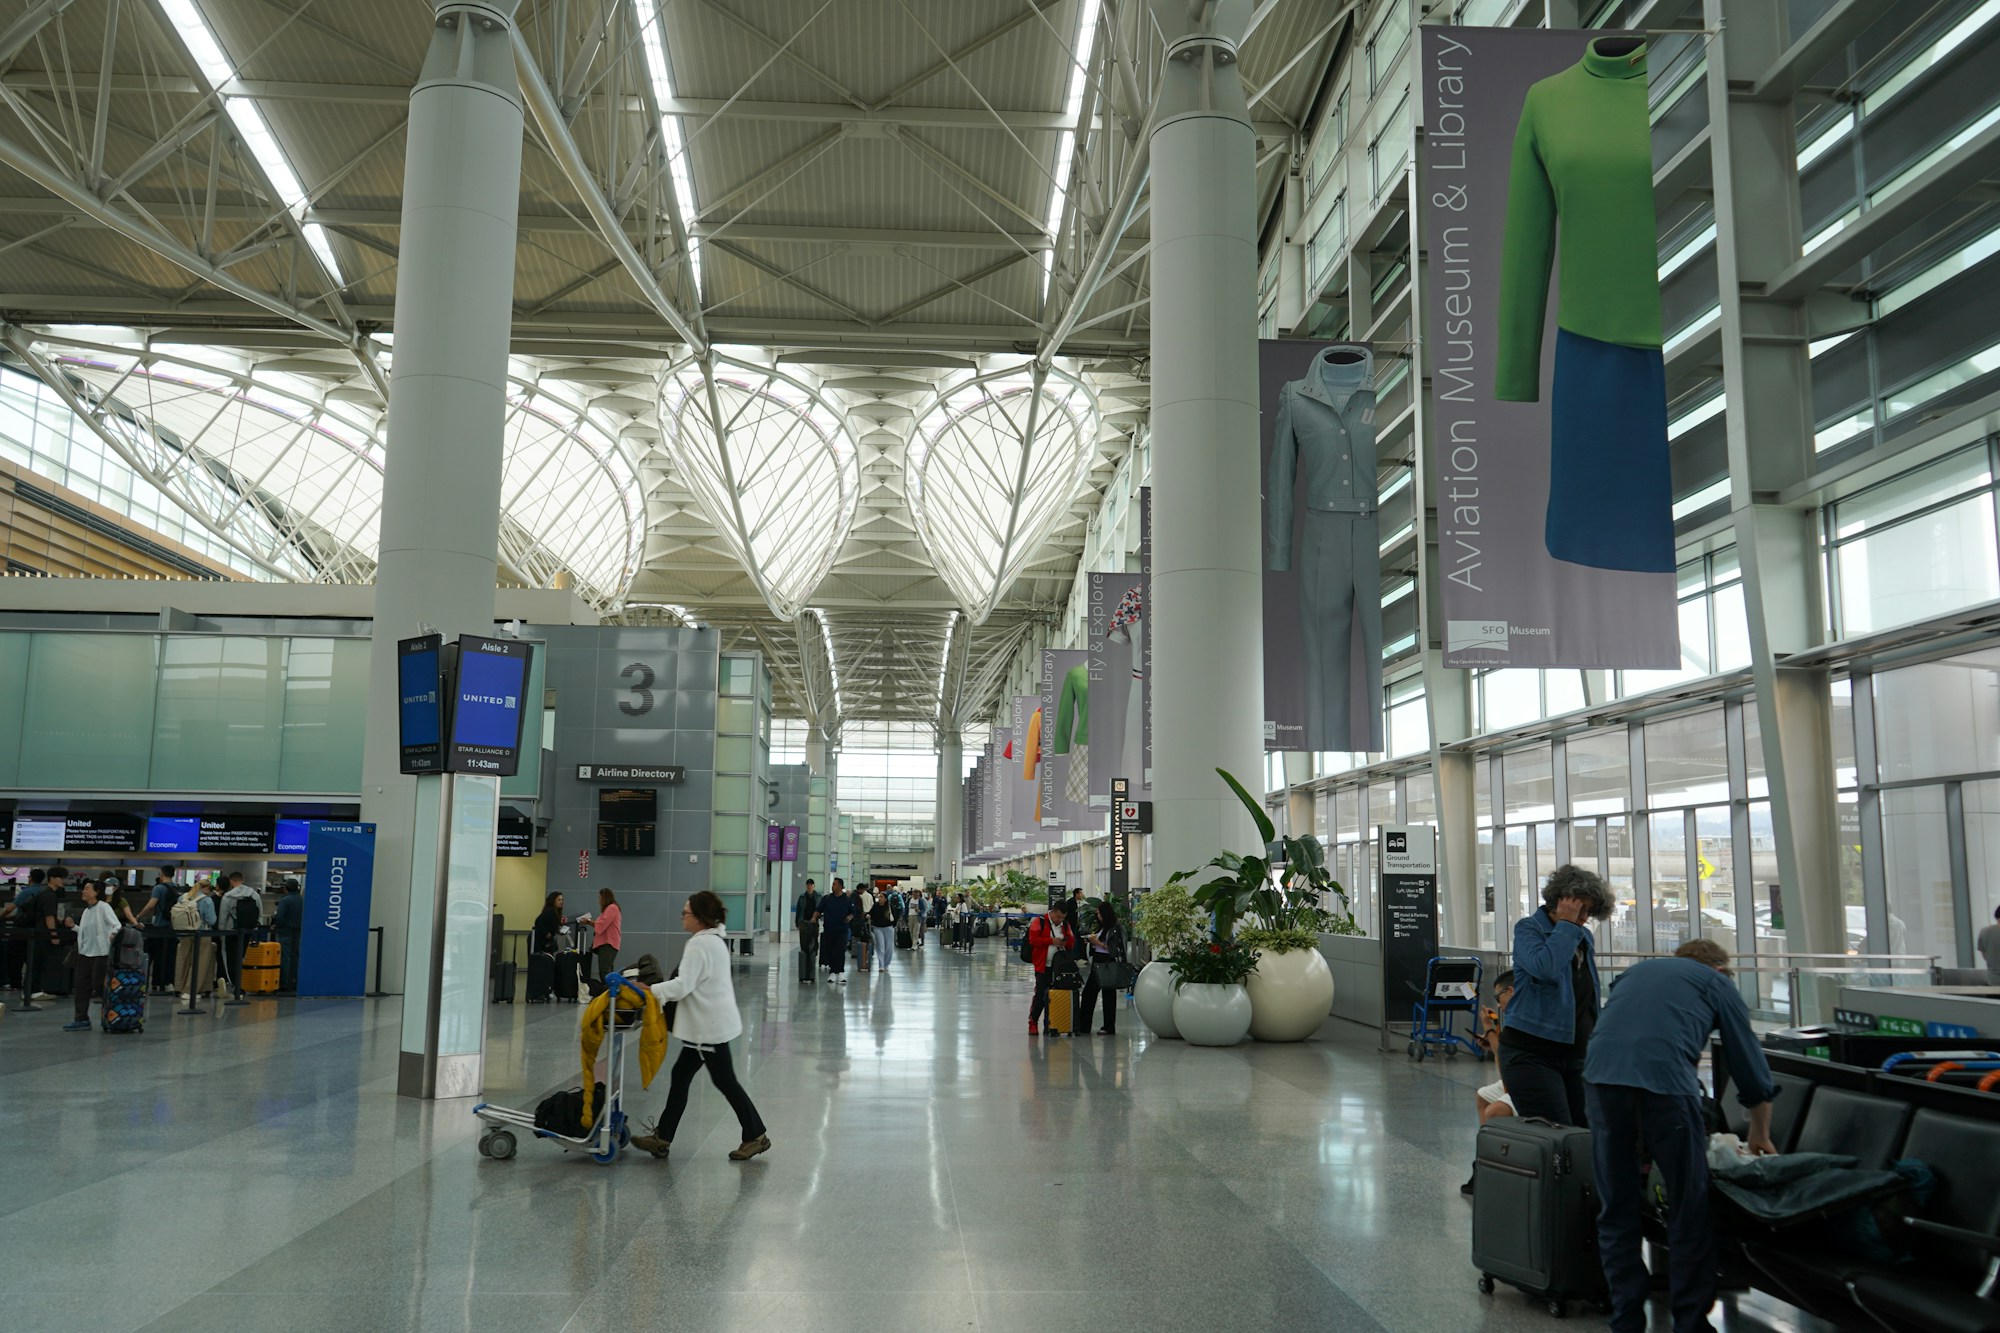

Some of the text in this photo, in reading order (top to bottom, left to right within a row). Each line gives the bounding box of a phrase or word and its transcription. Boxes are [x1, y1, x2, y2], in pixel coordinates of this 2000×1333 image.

[1428, 34, 1483, 592] Aviation Museum & Library
[1089, 574, 1107, 681] Fly & Explore
[1482, 626, 1551, 636] SFO Museum
[410, 643, 422, 652] Aisle
[481, 642, 501, 652] Aisle
[1042, 651, 1055, 692] Library
[404, 694, 428, 704] UNITED
[463, 694, 503, 705] UNITED
[618, 662, 656, 716] 3
[1013, 697, 1024, 736] Explore
[994, 729, 1004, 756] Library
[1042, 707, 1053, 758] Museum
[412, 759, 431, 767] 11:43am
[467, 759, 500, 769] 11:43am
[1013, 748, 1024, 763] Fly
[597, 768, 675, 780] Airline Directory
[1042, 760, 1053, 810] Aviation
[325, 857, 347, 931] Economy
